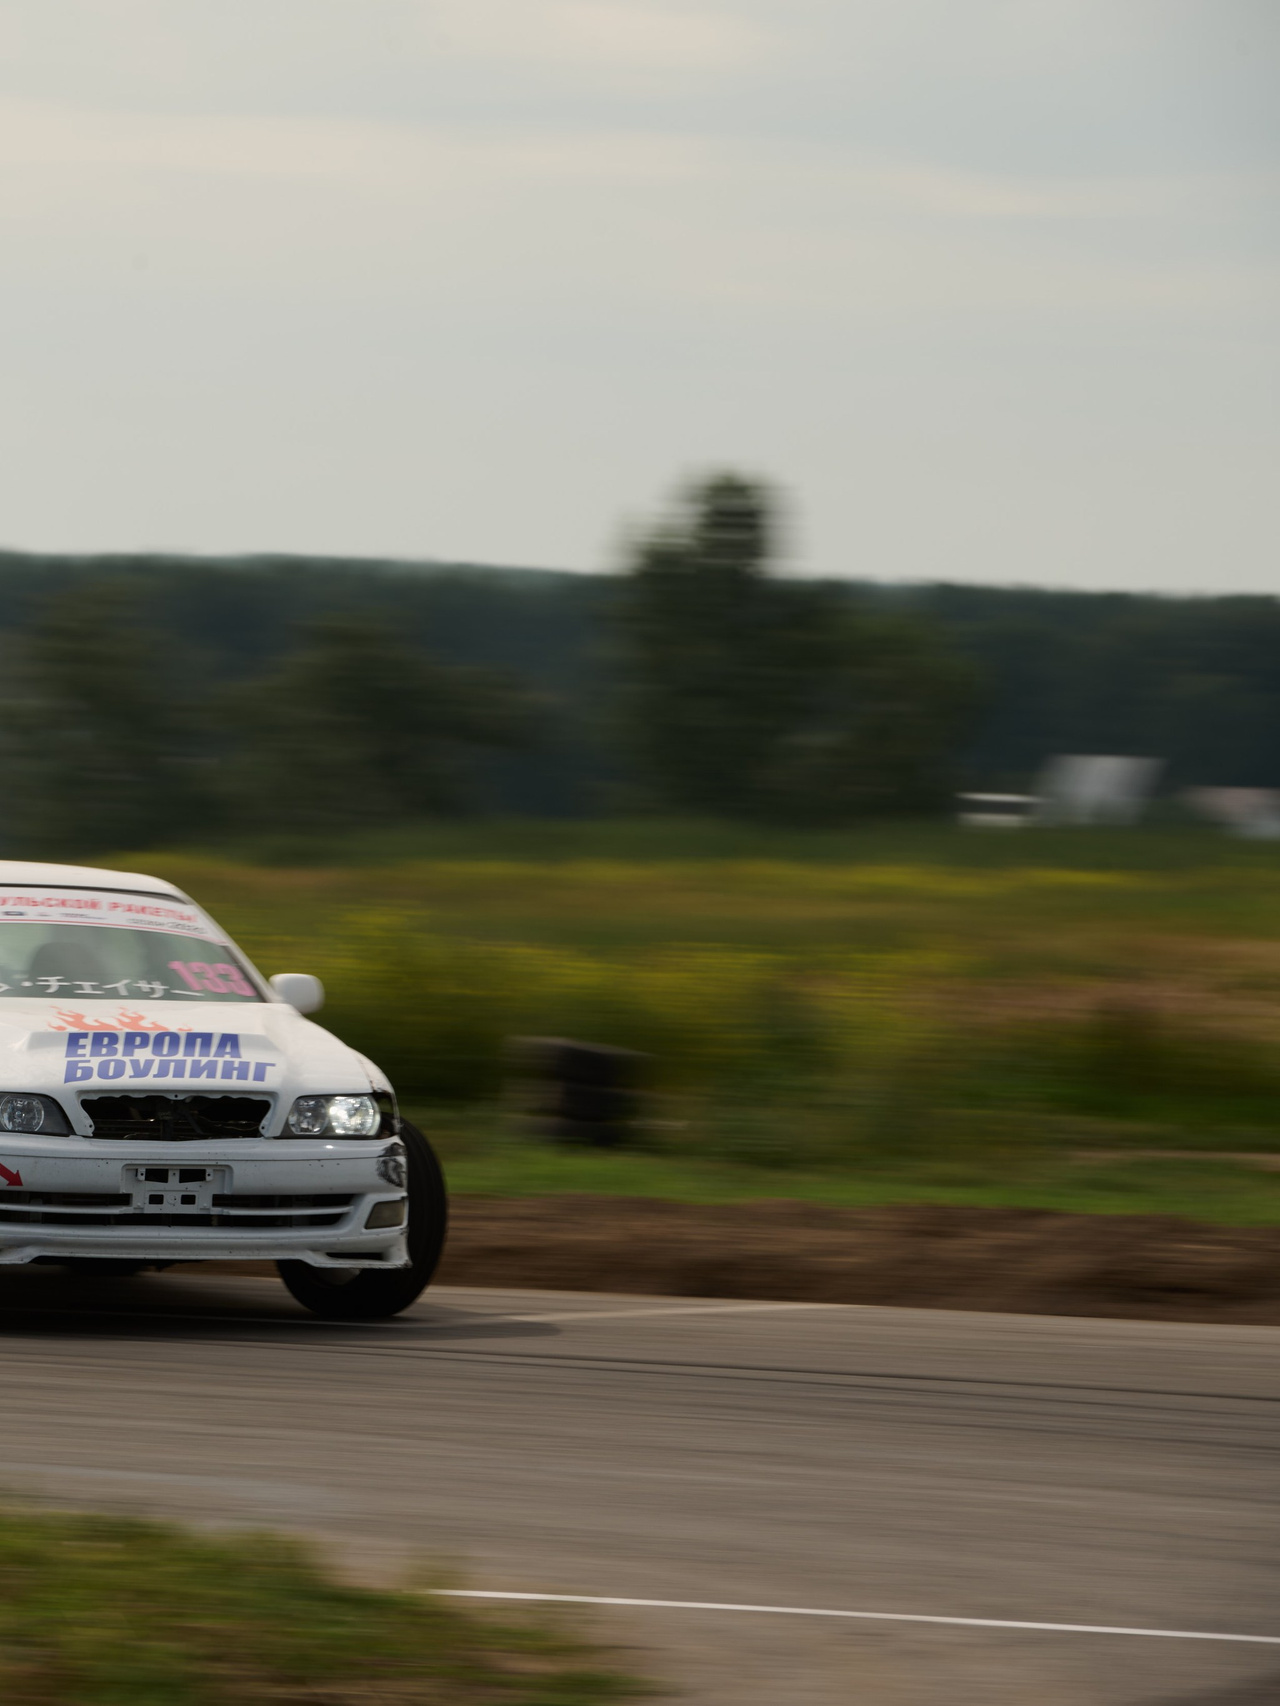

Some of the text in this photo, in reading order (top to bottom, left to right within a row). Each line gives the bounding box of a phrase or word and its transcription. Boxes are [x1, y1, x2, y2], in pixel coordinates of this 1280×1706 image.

[107, 902, 198, 923] РАКЕТЫ
[167, 960, 258, 997] 133
[64, 1031, 243, 1059] ЕВРОПА
[63, 1058, 276, 1084] БОУЛИНГ
